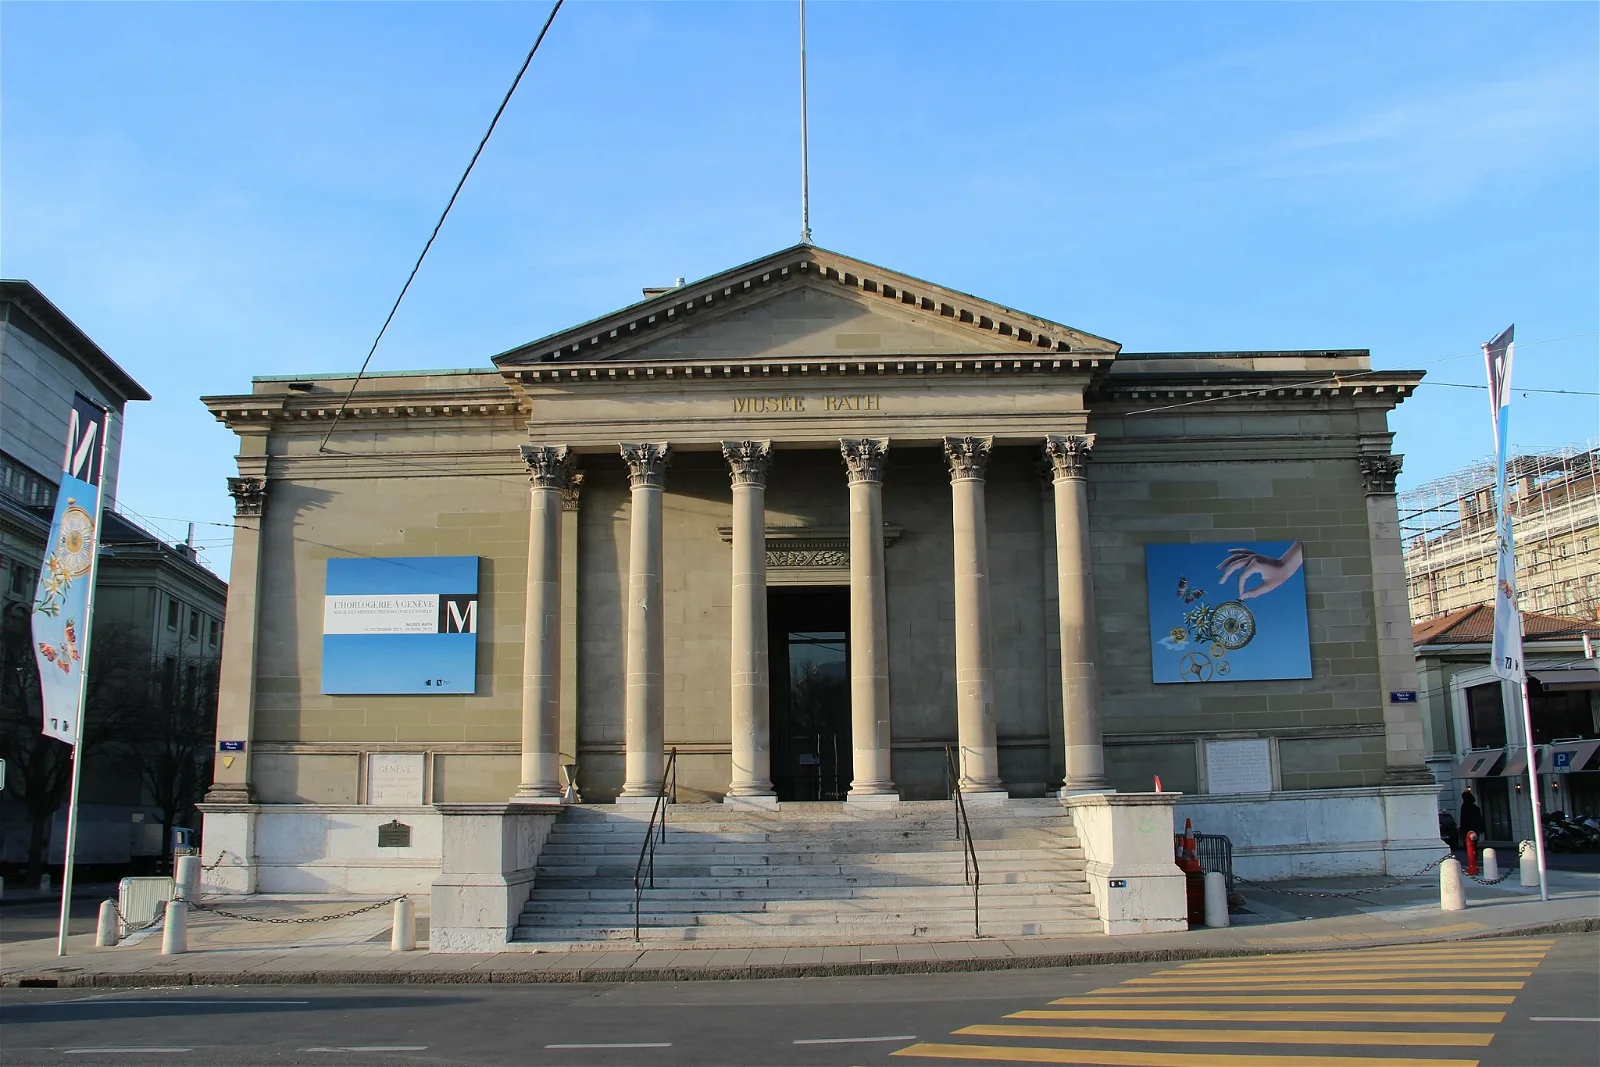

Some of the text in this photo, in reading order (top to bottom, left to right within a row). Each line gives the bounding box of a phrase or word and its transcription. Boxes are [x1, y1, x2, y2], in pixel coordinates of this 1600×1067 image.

[823, 394, 880, 411] RATH
[446, 600, 478, 634] M
[1557, 754, 1566, 766] P
